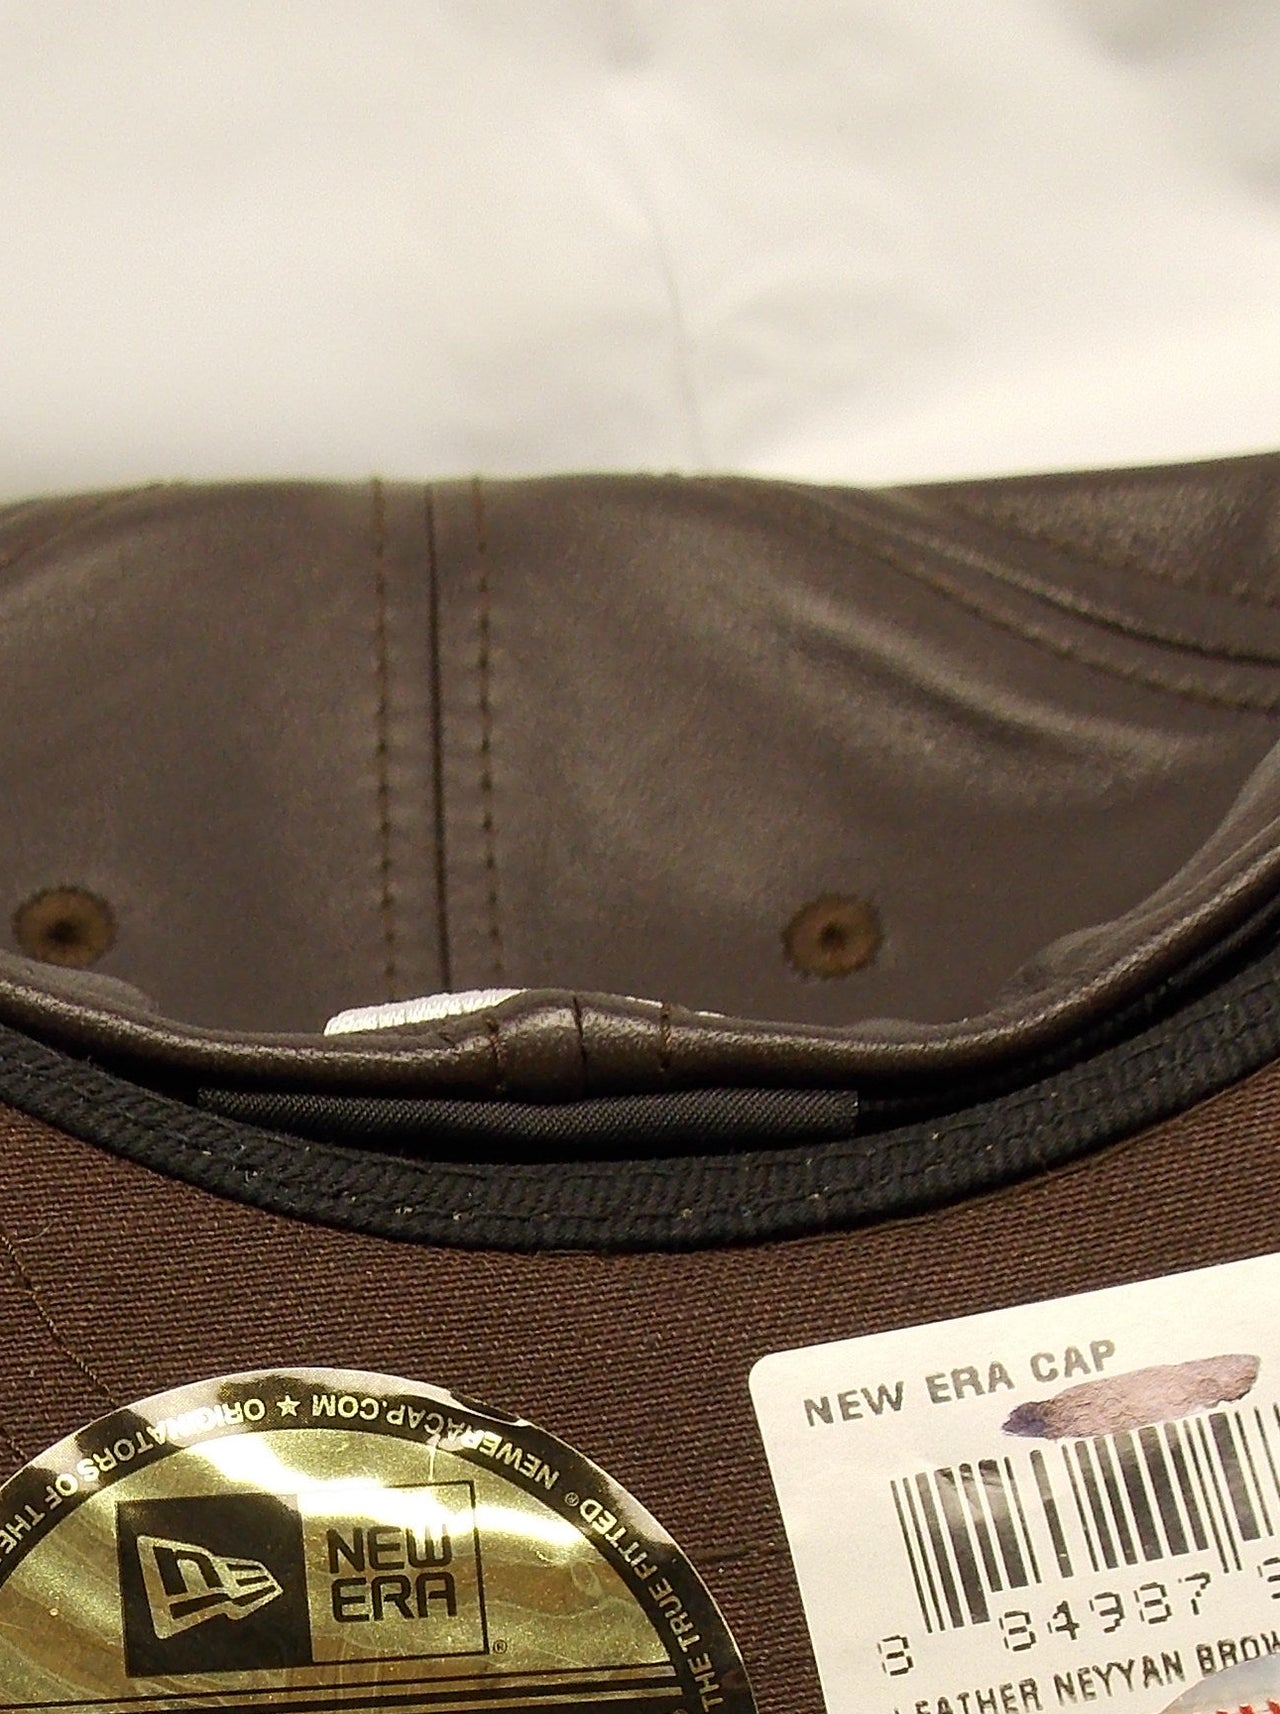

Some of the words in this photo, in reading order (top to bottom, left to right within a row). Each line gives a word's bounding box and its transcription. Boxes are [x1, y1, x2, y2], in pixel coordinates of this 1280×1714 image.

[803, 1381, 904, 1427] NEW
[925, 1361, 1015, 1404] ERA
[1030, 1339, 1115, 1383] CAP
[45, 1473, 80, 1512] OF
[326, 1524, 452, 1574] NEW
[331, 1571, 458, 1623] ERA
[649, 1581, 701, 1653] TRUE
[877, 1635, 913, 1676] 8
[999, 1572, 1211, 1652] 84987
[686, 1652, 726, 1714] THE
[1053, 1651, 1186, 1705] NEYYAN
